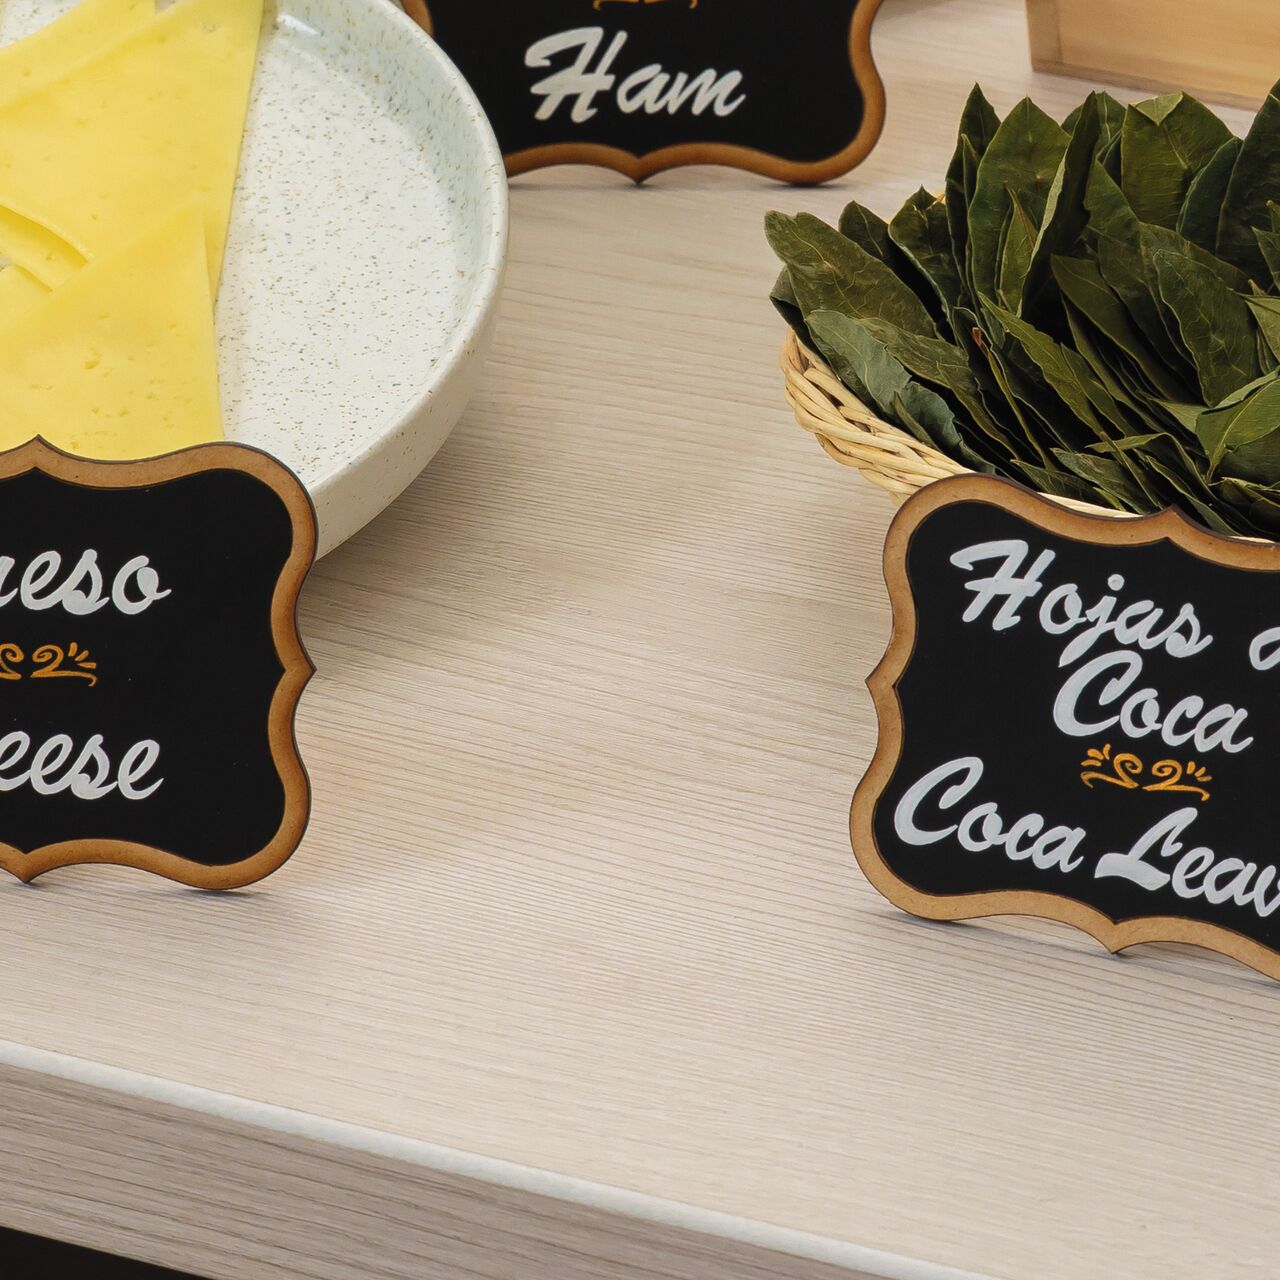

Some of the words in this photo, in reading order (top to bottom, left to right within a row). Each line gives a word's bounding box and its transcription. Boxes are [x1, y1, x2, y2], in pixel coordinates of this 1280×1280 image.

[524, 26, 747, 123] Ham
[948, 538, 1214, 668] Hojas
[1052, 649, 1255, 754] Coca
[893, 755, 1084, 871] Coca
